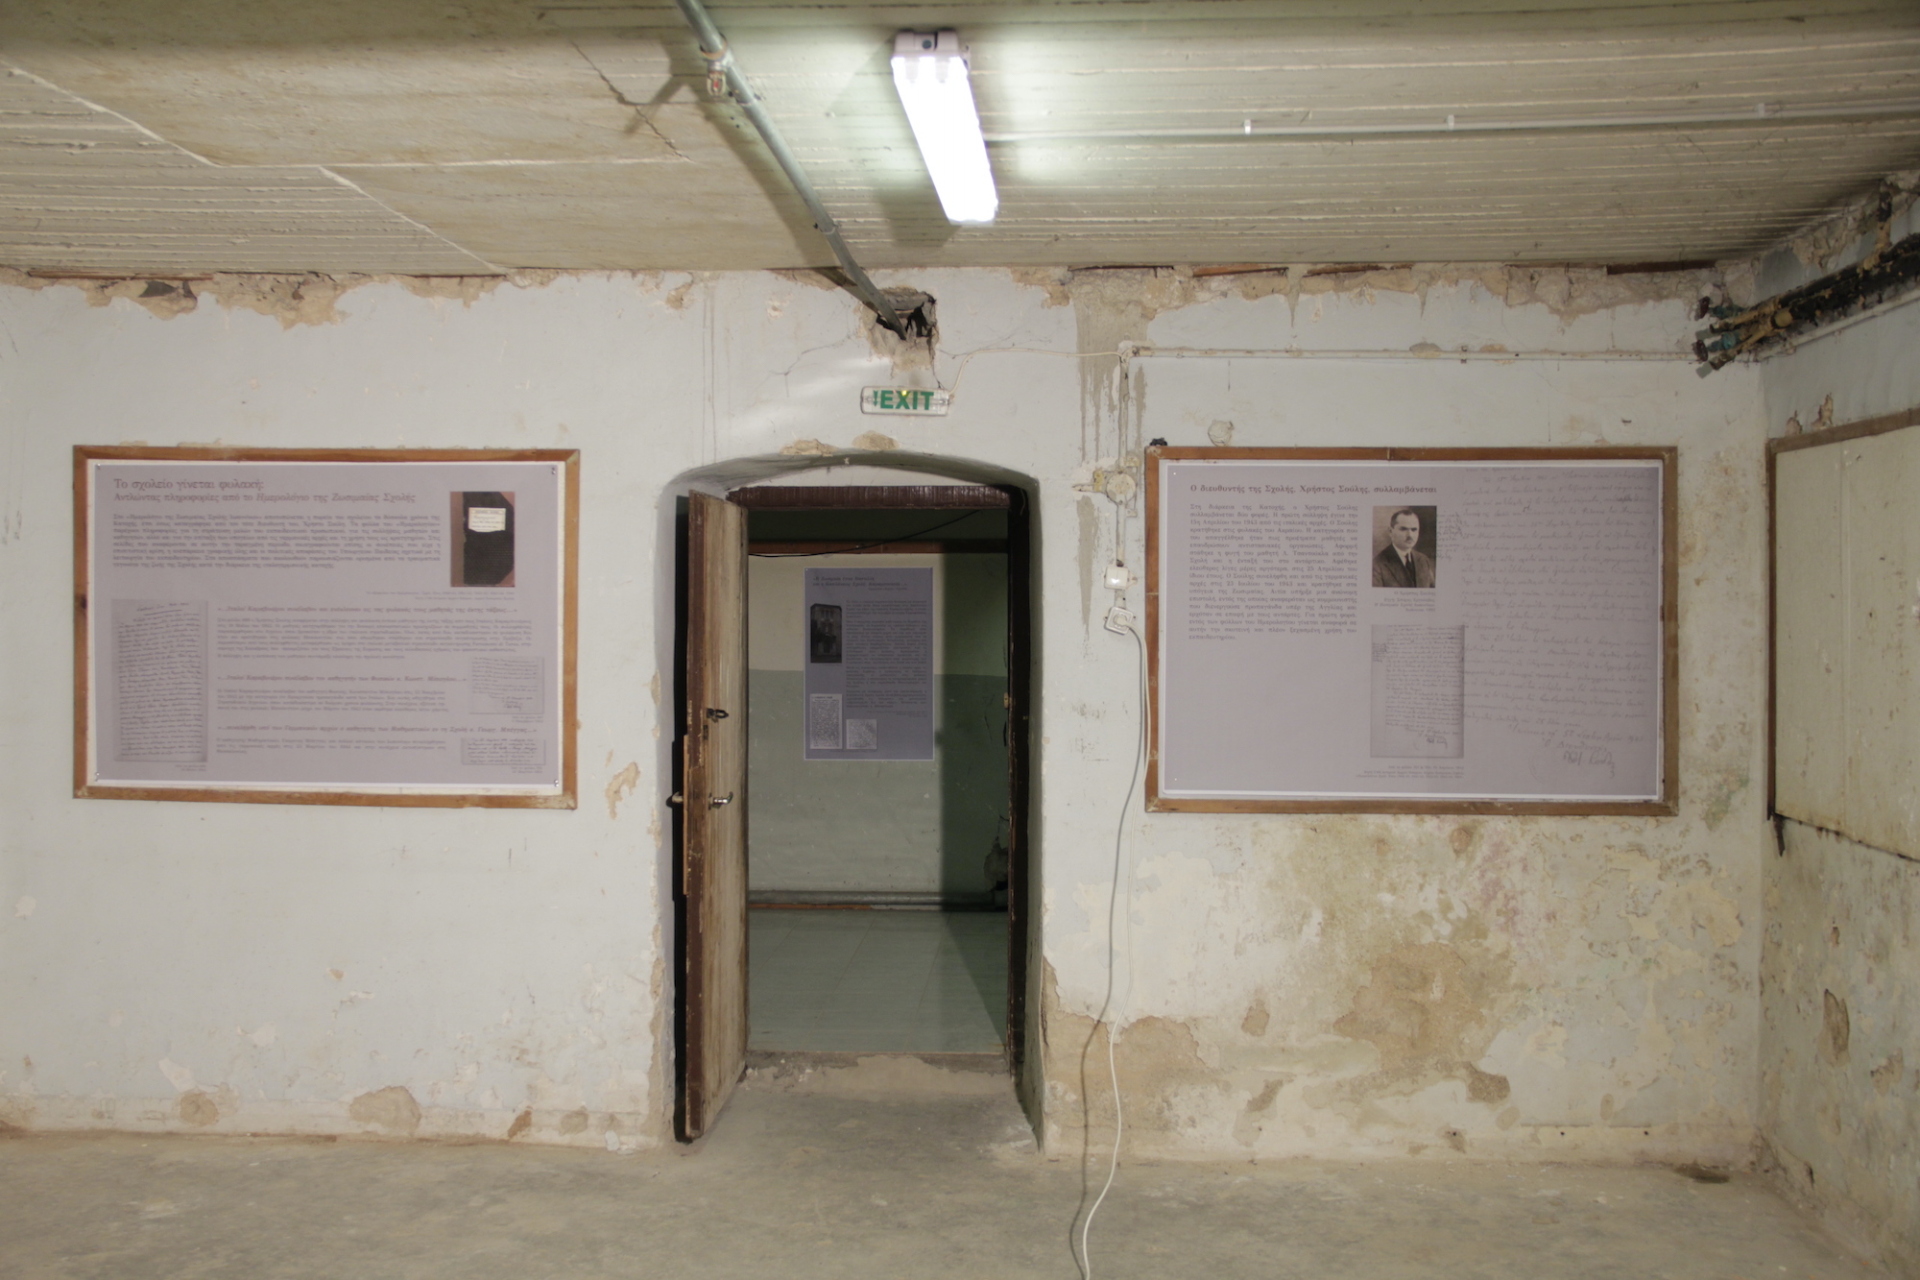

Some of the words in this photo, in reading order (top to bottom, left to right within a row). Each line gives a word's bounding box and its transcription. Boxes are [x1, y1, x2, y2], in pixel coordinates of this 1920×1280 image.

[880, 389, 934, 411] EXIT
[114, 479, 128, 488] Το
[132, 479, 173, 491] σχολείο
[177, 479, 215, 491] γίνεται
[219, 479, 266, 491] φυλακή:
[1200, 485, 1245, 494] διευθυντής
[1300, 485, 1335, 494] Χρήστος
[1374, 486, 1437, 494] συλλαμβάνεται
